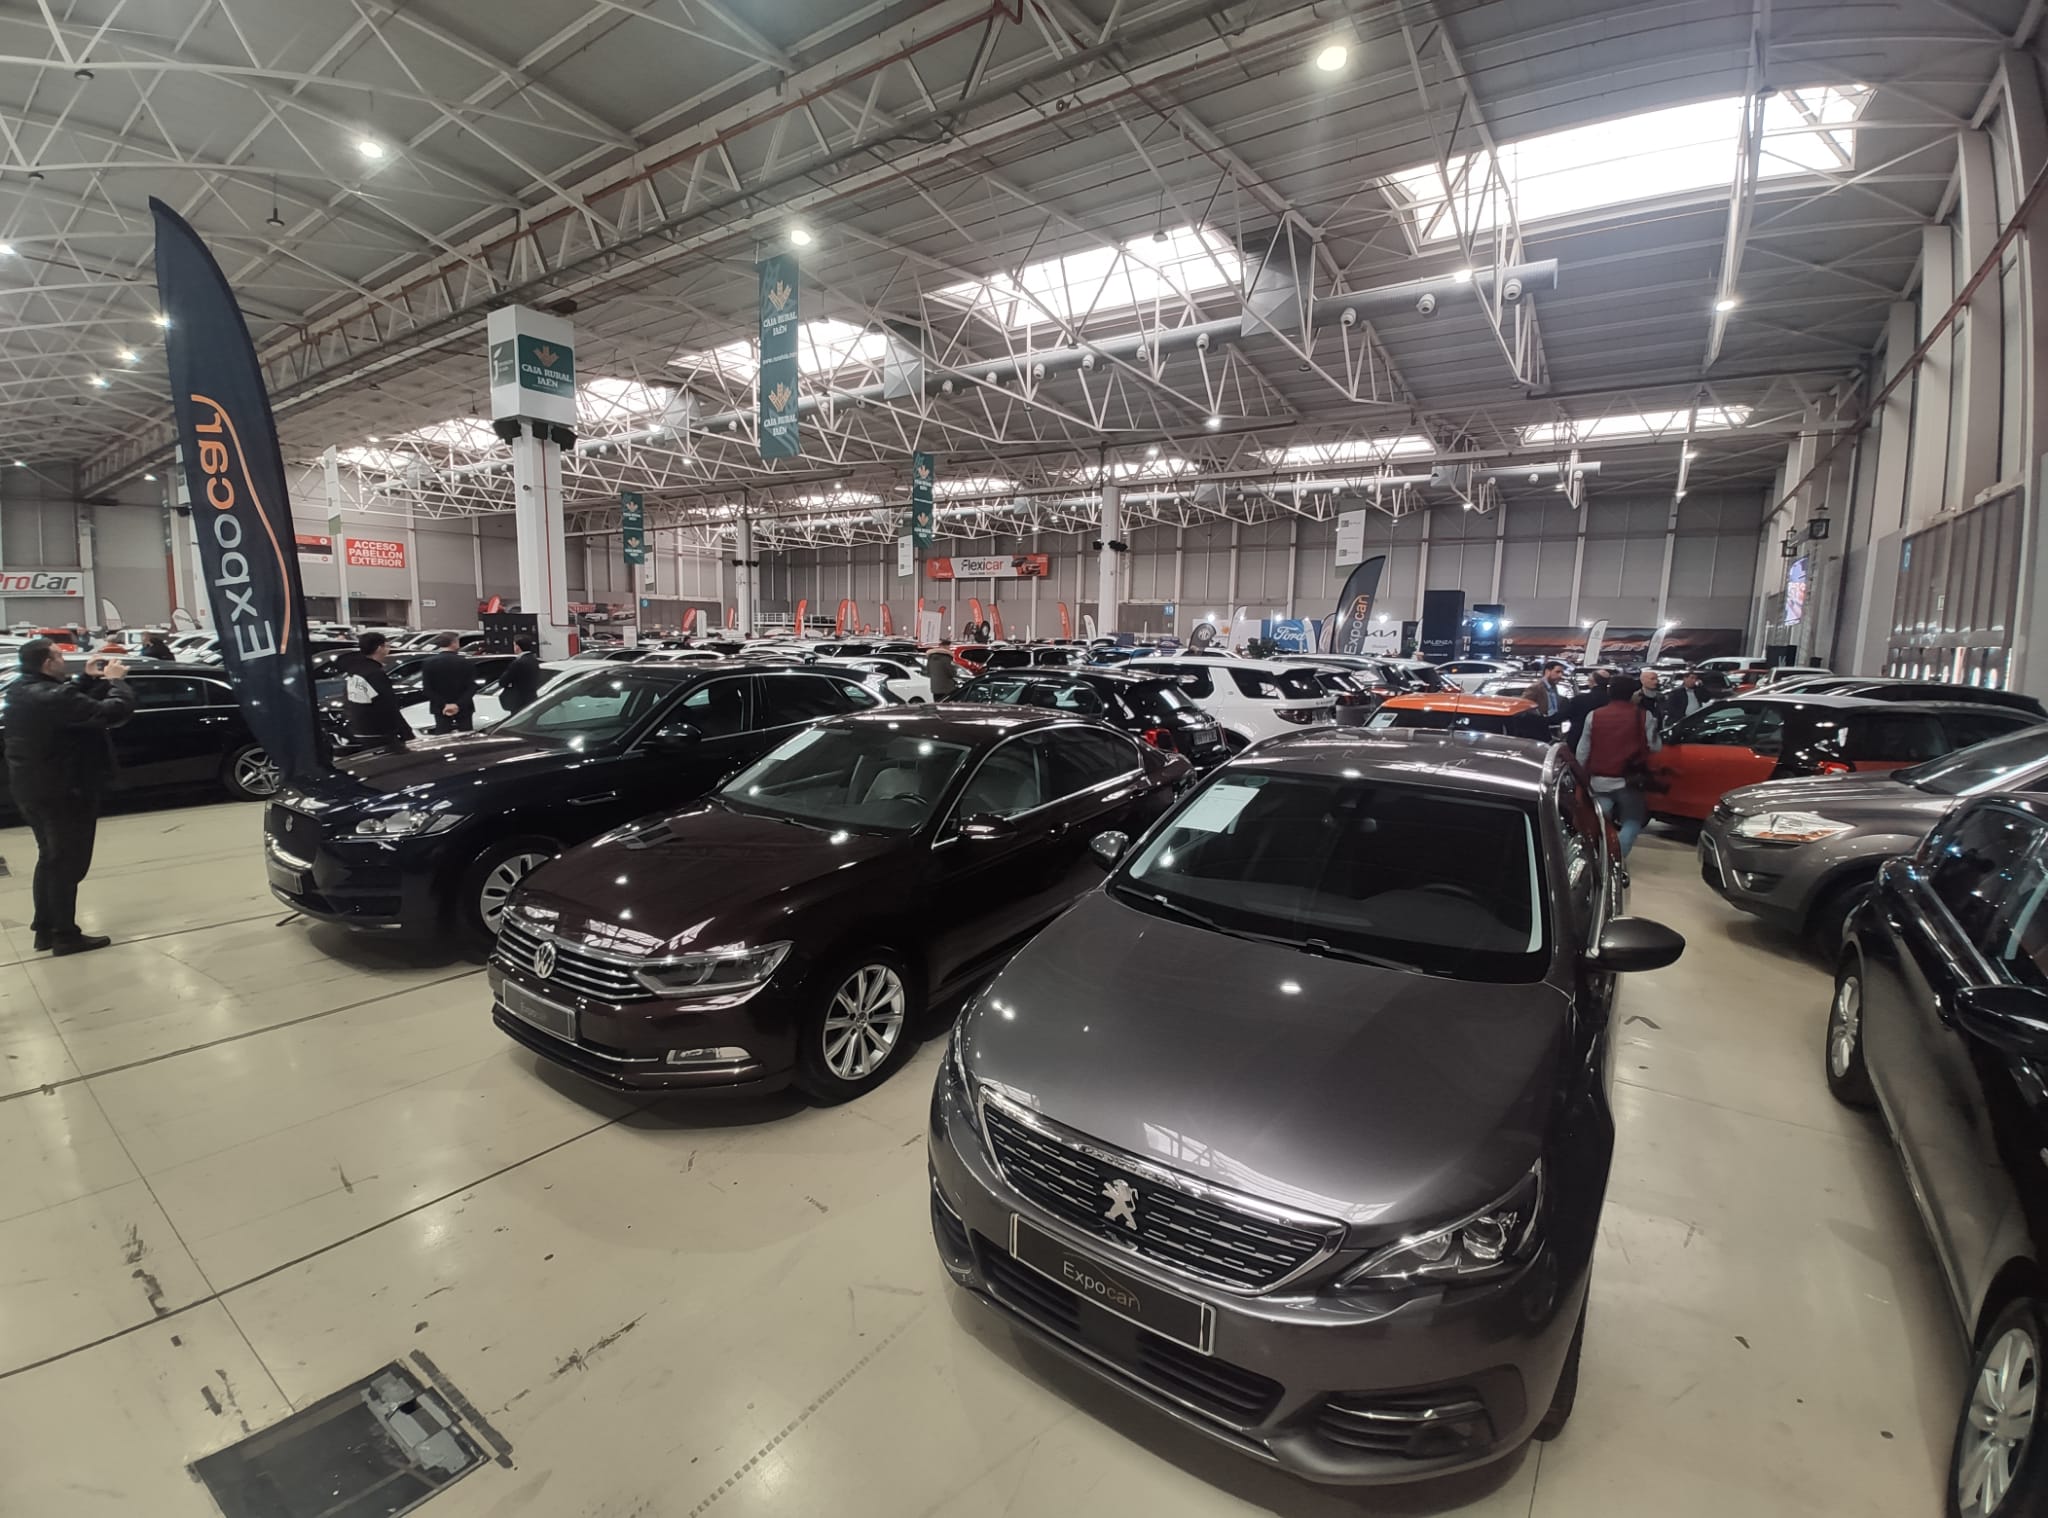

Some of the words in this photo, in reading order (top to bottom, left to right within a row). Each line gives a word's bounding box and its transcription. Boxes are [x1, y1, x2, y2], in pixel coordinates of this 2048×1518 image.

[544, 368, 573, 383] RURAL
[353, 540, 397, 551] ACCESO
[348, 548, 403, 560] PABELLON
[350, 556, 402, 567] EXTERIOR
[961, 558, 1004, 572] Flexicar
[1273, 626, 1306, 641] Ford
